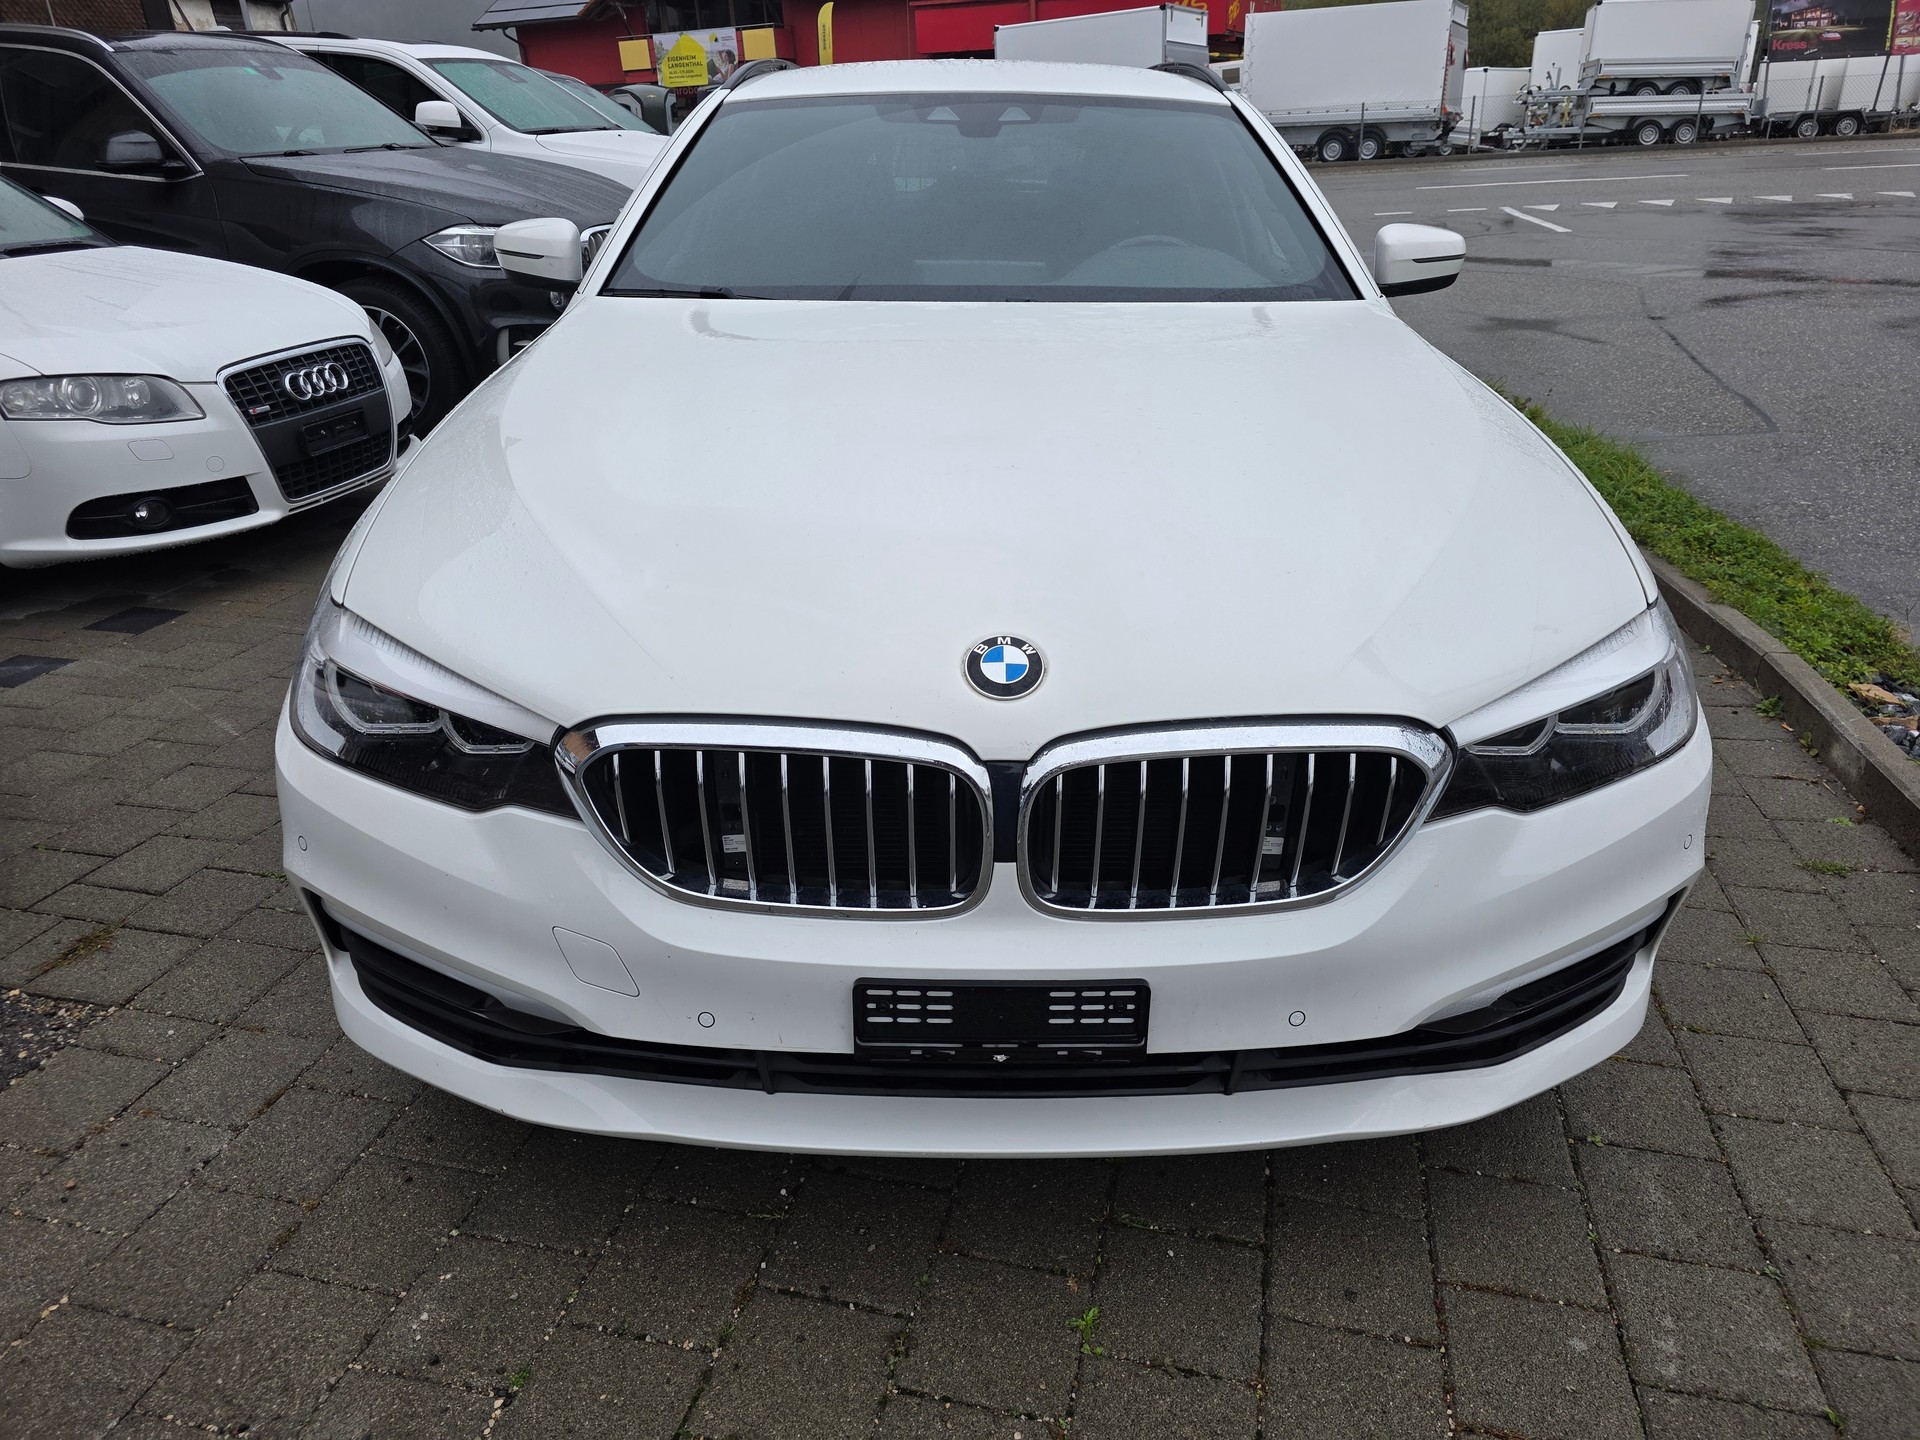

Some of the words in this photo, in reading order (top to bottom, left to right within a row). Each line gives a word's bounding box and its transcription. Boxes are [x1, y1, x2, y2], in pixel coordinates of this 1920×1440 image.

[1772, 39, 1807, 50] Kress
[667, 61, 703, 69] LANGENTHAL
[973, 636, 1036, 655] BMW
